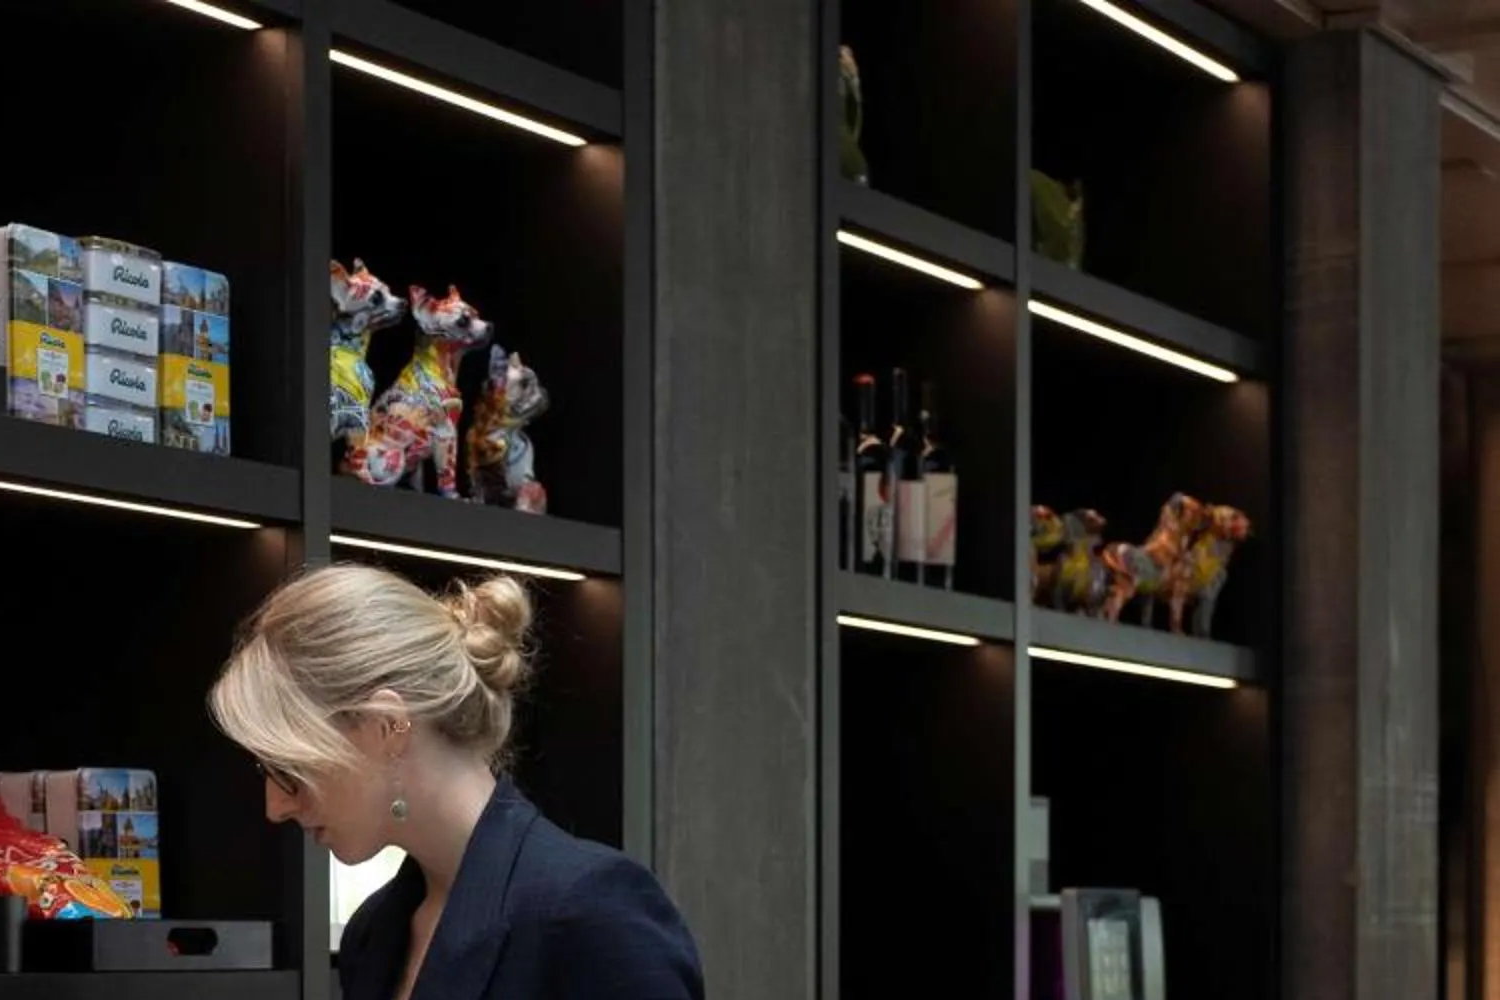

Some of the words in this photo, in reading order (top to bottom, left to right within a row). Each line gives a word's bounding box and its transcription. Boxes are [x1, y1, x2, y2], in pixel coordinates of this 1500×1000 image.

[112, 265, 149, 289] Ricola
[111, 317, 148, 341] Ricola
[109, 368, 146, 392] Ricola
